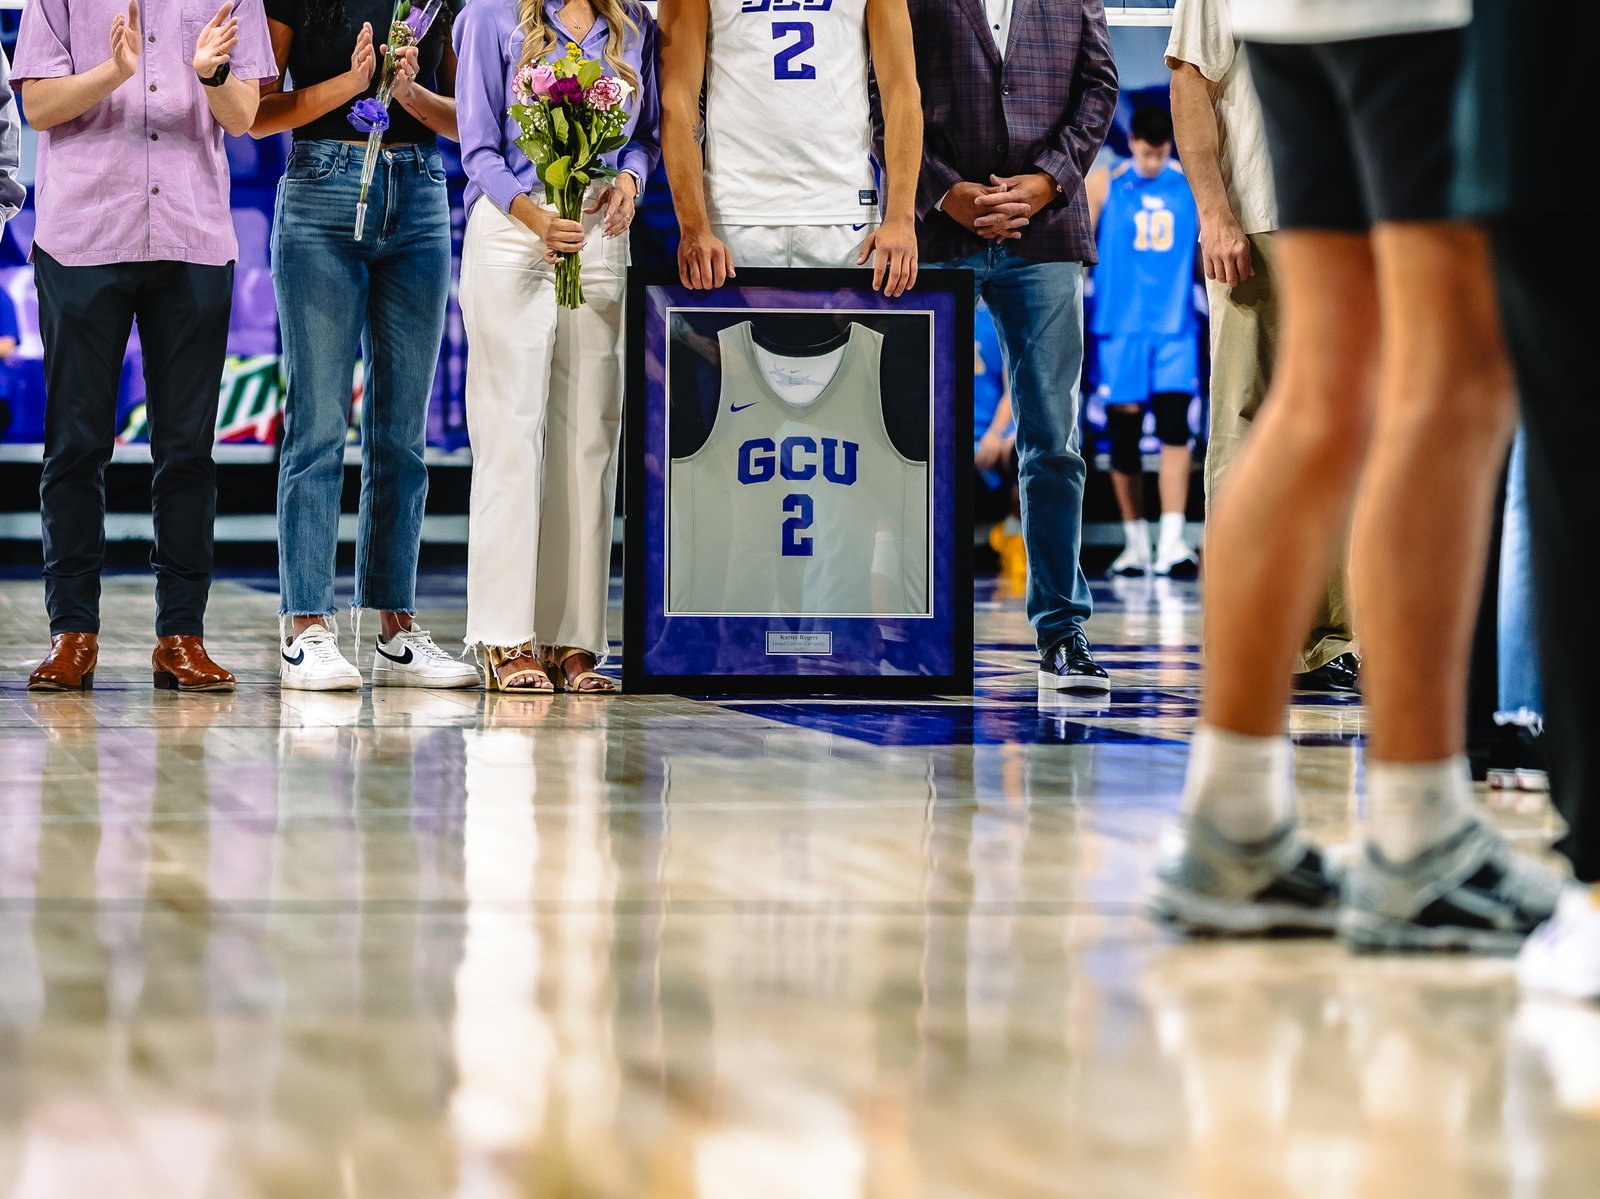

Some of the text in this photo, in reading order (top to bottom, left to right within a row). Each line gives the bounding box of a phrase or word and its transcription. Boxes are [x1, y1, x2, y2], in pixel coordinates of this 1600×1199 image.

[771, 21, 817, 81] 2
[1133, 209, 1175, 251] 10
[737, 436, 860, 487] GCU
[781, 493, 815, 557] 2
